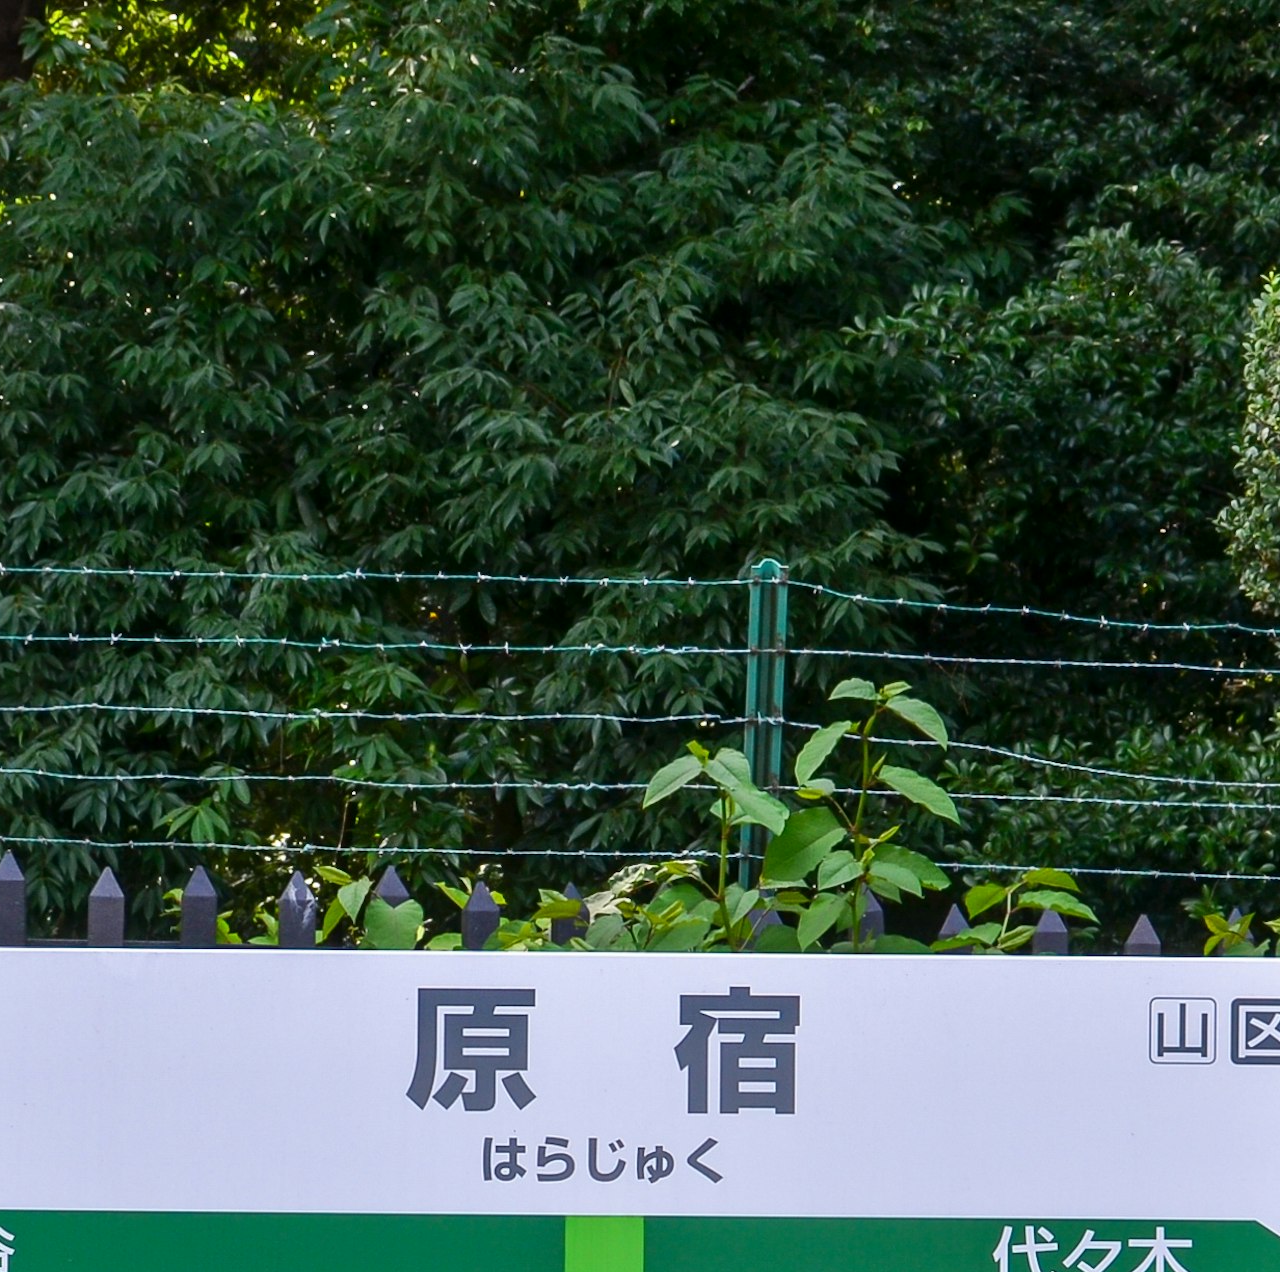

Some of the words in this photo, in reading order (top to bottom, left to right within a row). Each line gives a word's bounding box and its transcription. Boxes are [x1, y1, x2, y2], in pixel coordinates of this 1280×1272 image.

[406, 987, 801, 1114] 原宿
[1157, 1003, 1208, 1057] 山
[483, 1135, 723, 1184] はらじゅく
